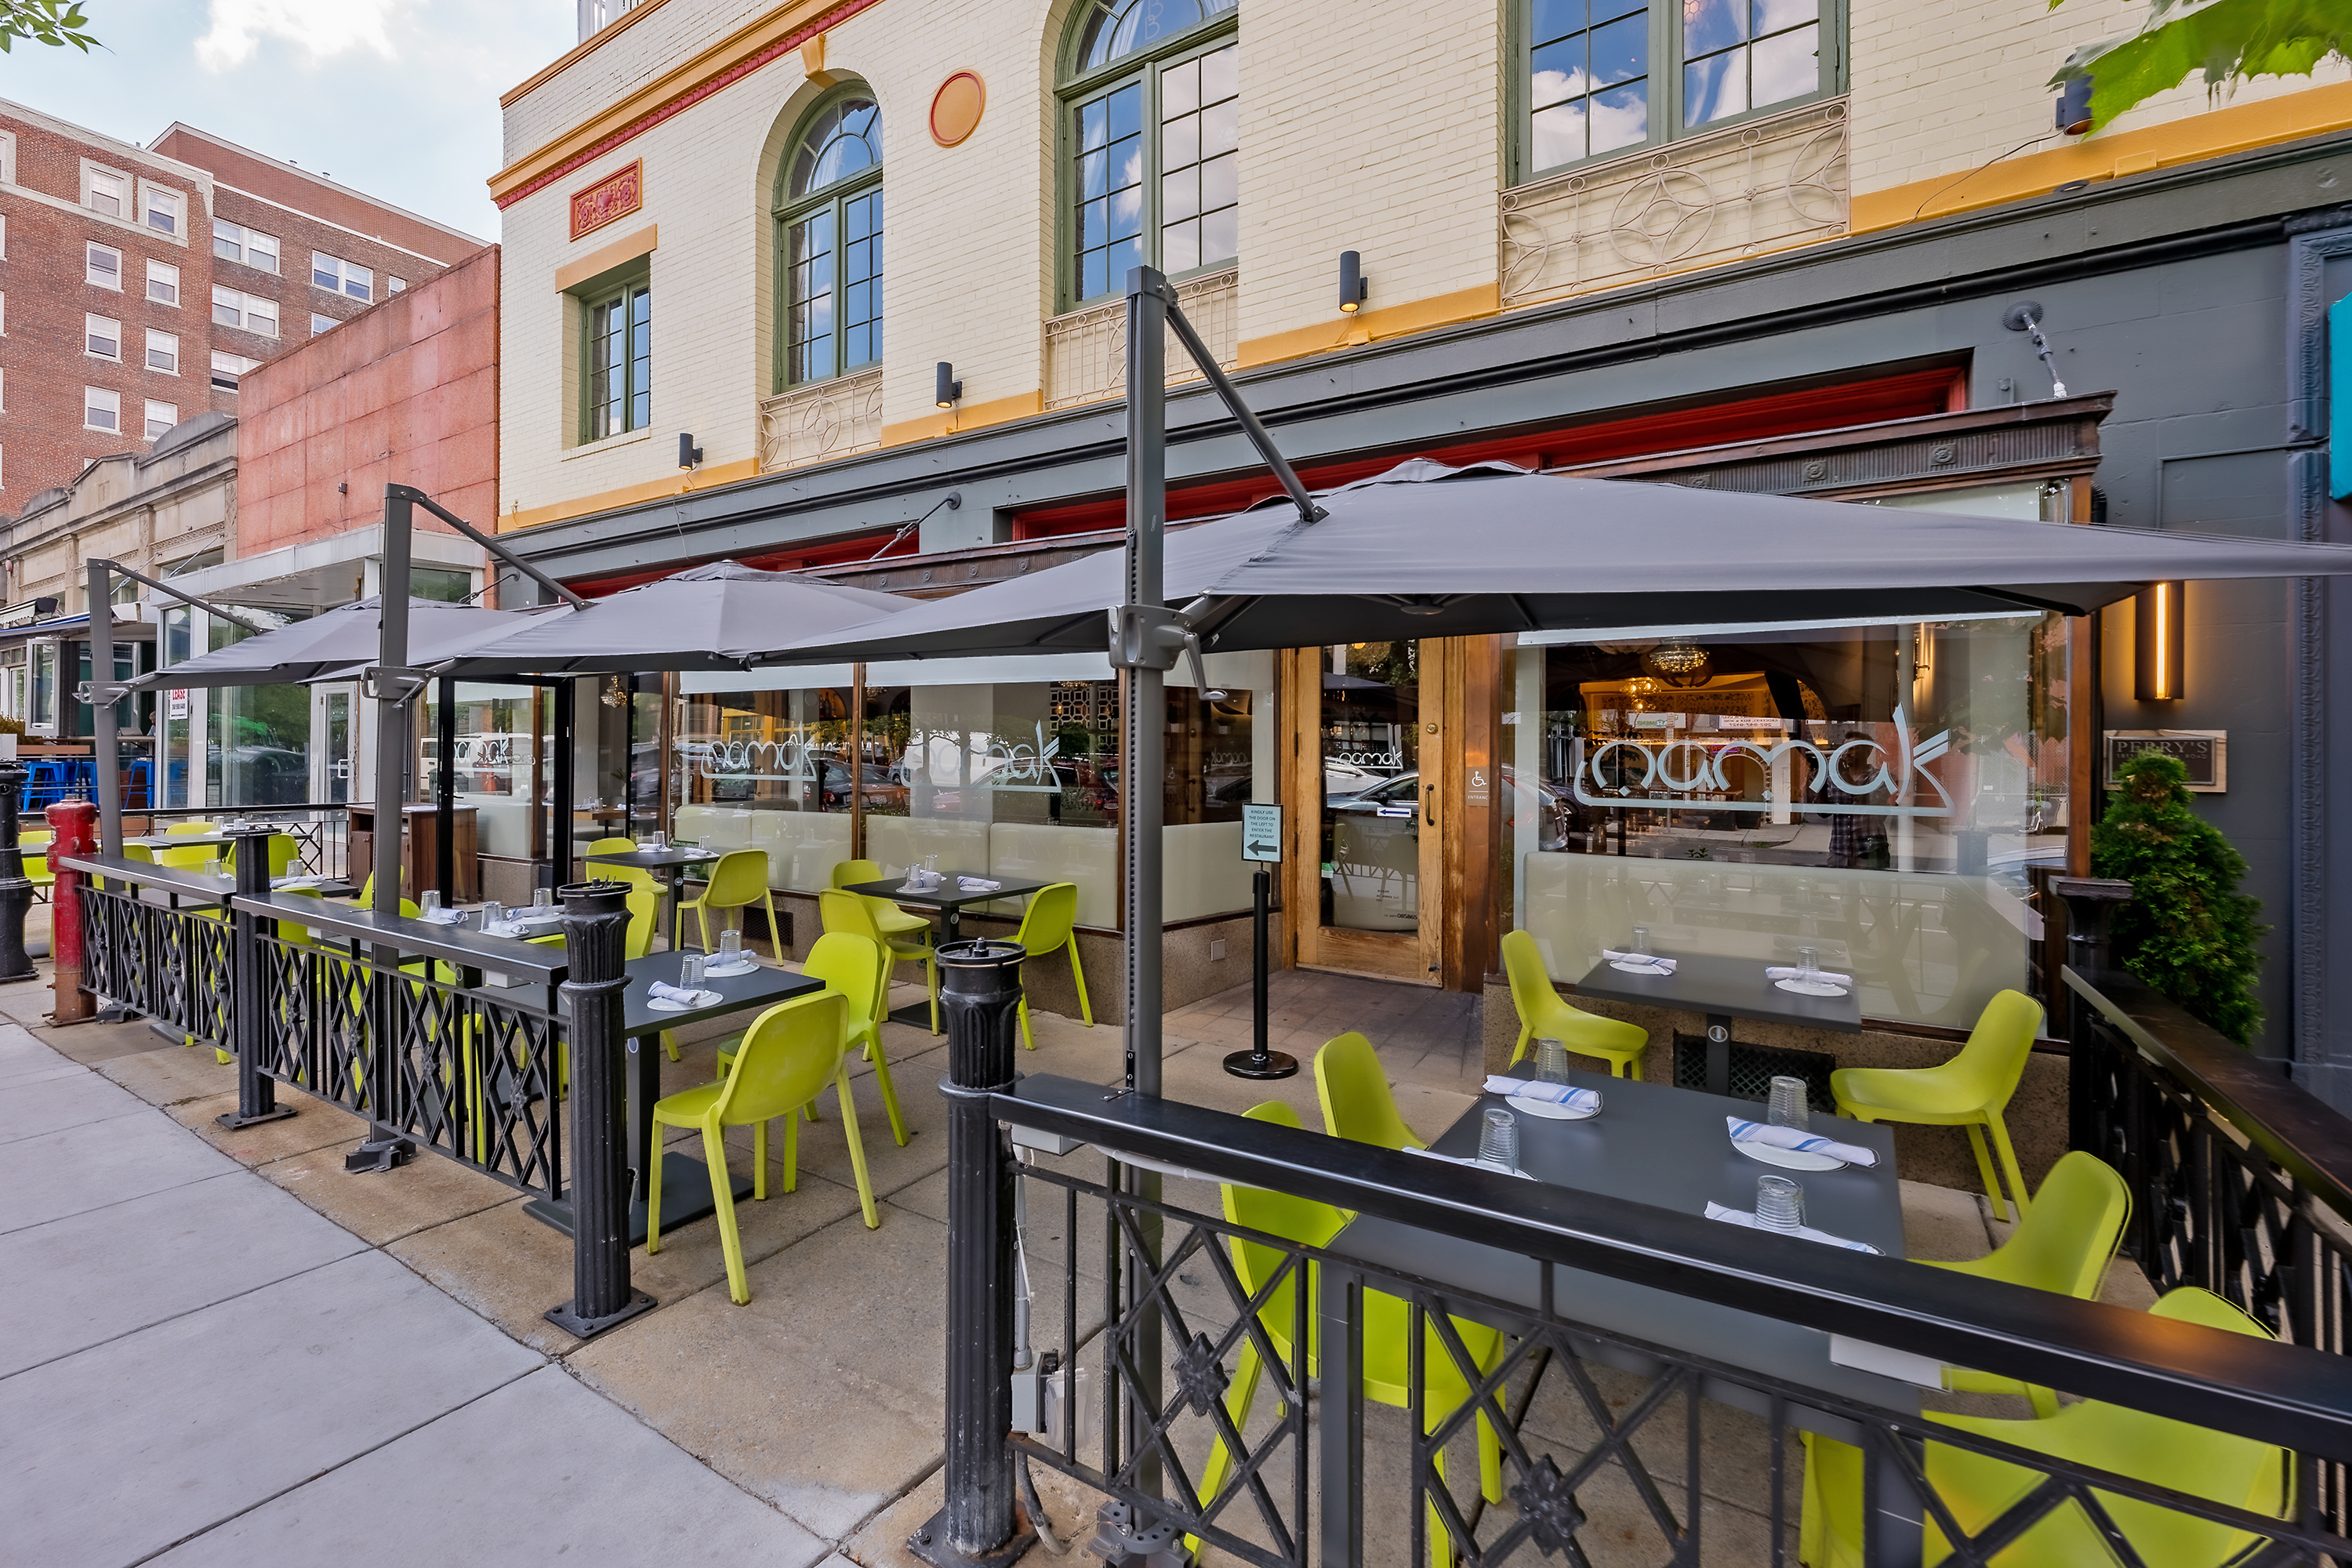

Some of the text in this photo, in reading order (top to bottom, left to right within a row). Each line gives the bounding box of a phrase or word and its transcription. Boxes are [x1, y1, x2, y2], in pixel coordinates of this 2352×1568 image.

[172, 689, 185, 700] LEASE
[454, 726, 510, 772] amak
[700, 720, 817, 781] namak
[902, 719, 1062, 793] namak
[1574, 702, 1955, 817] namak
[2117, 741, 2208, 753] PERRY'S
